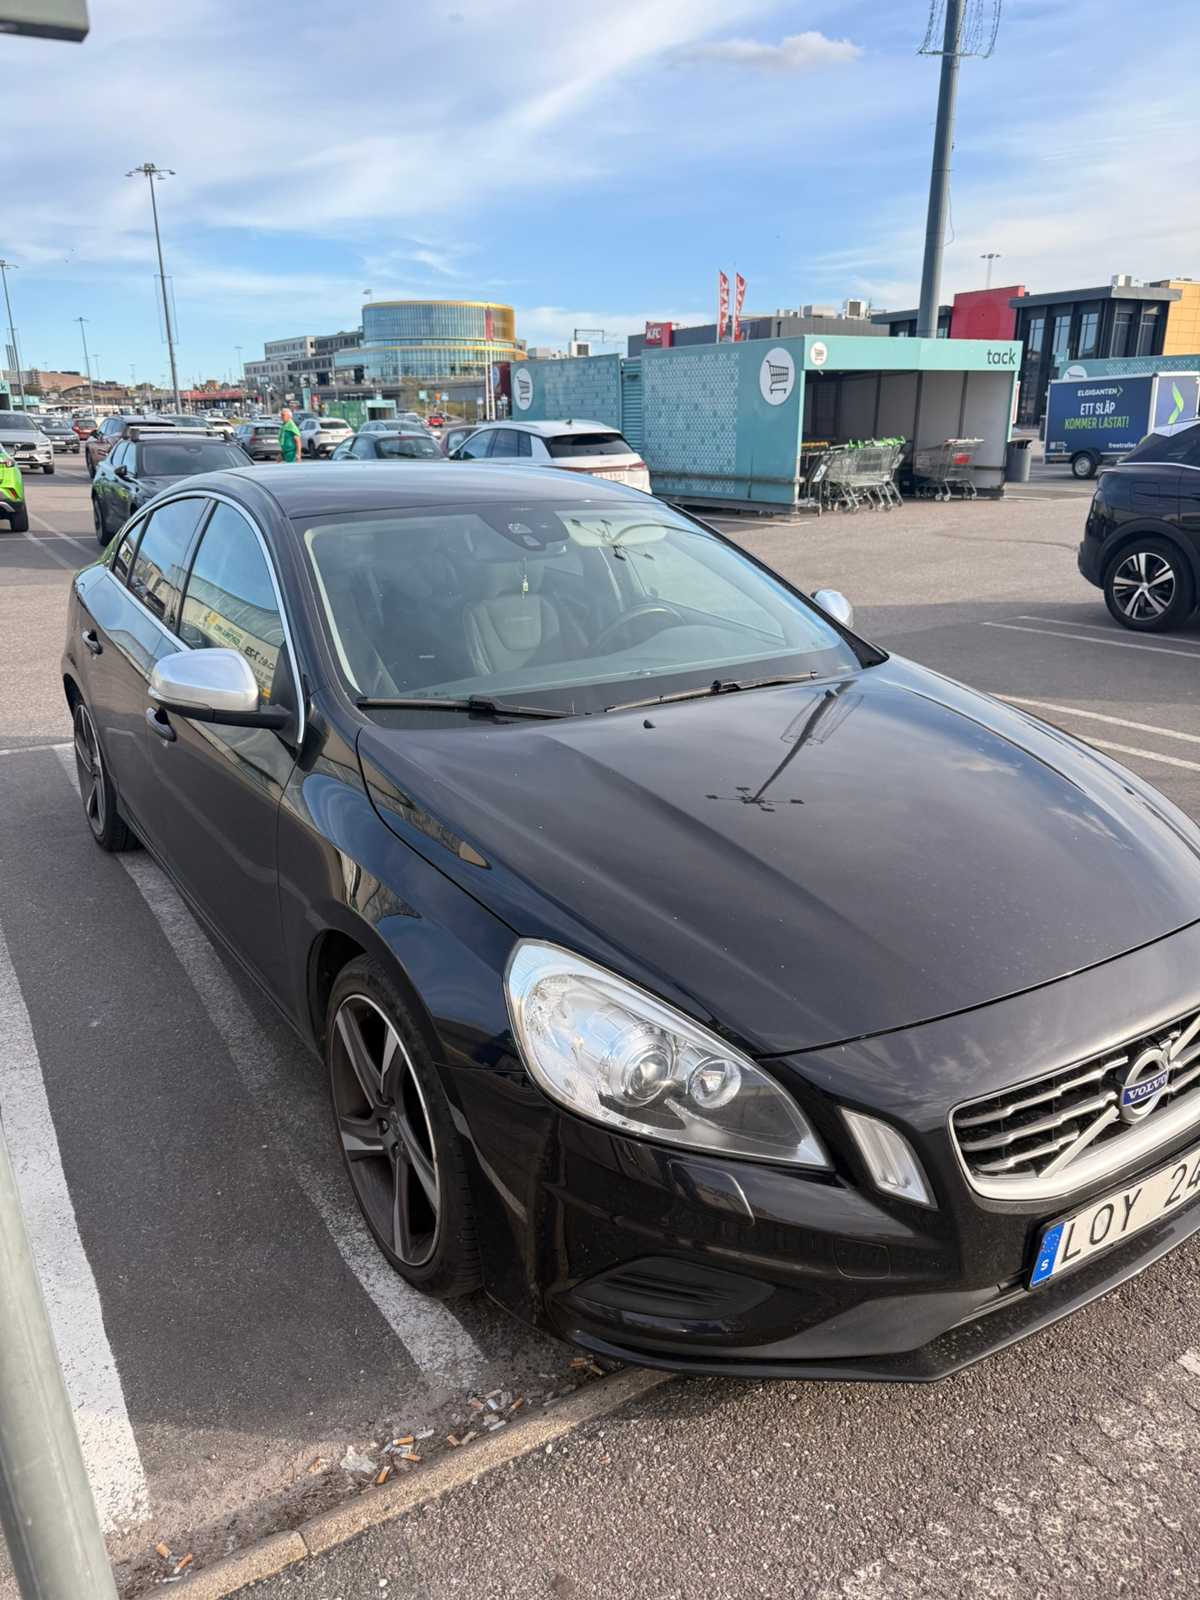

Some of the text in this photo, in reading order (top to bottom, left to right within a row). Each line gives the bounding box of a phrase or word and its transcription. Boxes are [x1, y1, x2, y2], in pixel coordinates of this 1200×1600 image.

[646, 328, 661, 340] KFC
[987, 348, 1016, 365] tack
[1078, 388, 1117, 397] ELGIGANTEN
[1080, 400, 1116, 415] ETT SLÄP
[1064, 416, 1129, 430] KOMMER LASTAT!
[1127, 1074, 1167, 1099] VOLVO
[1061, 1188, 1142, 1264] LOY
[1040, 1259, 1050, 1271] S
